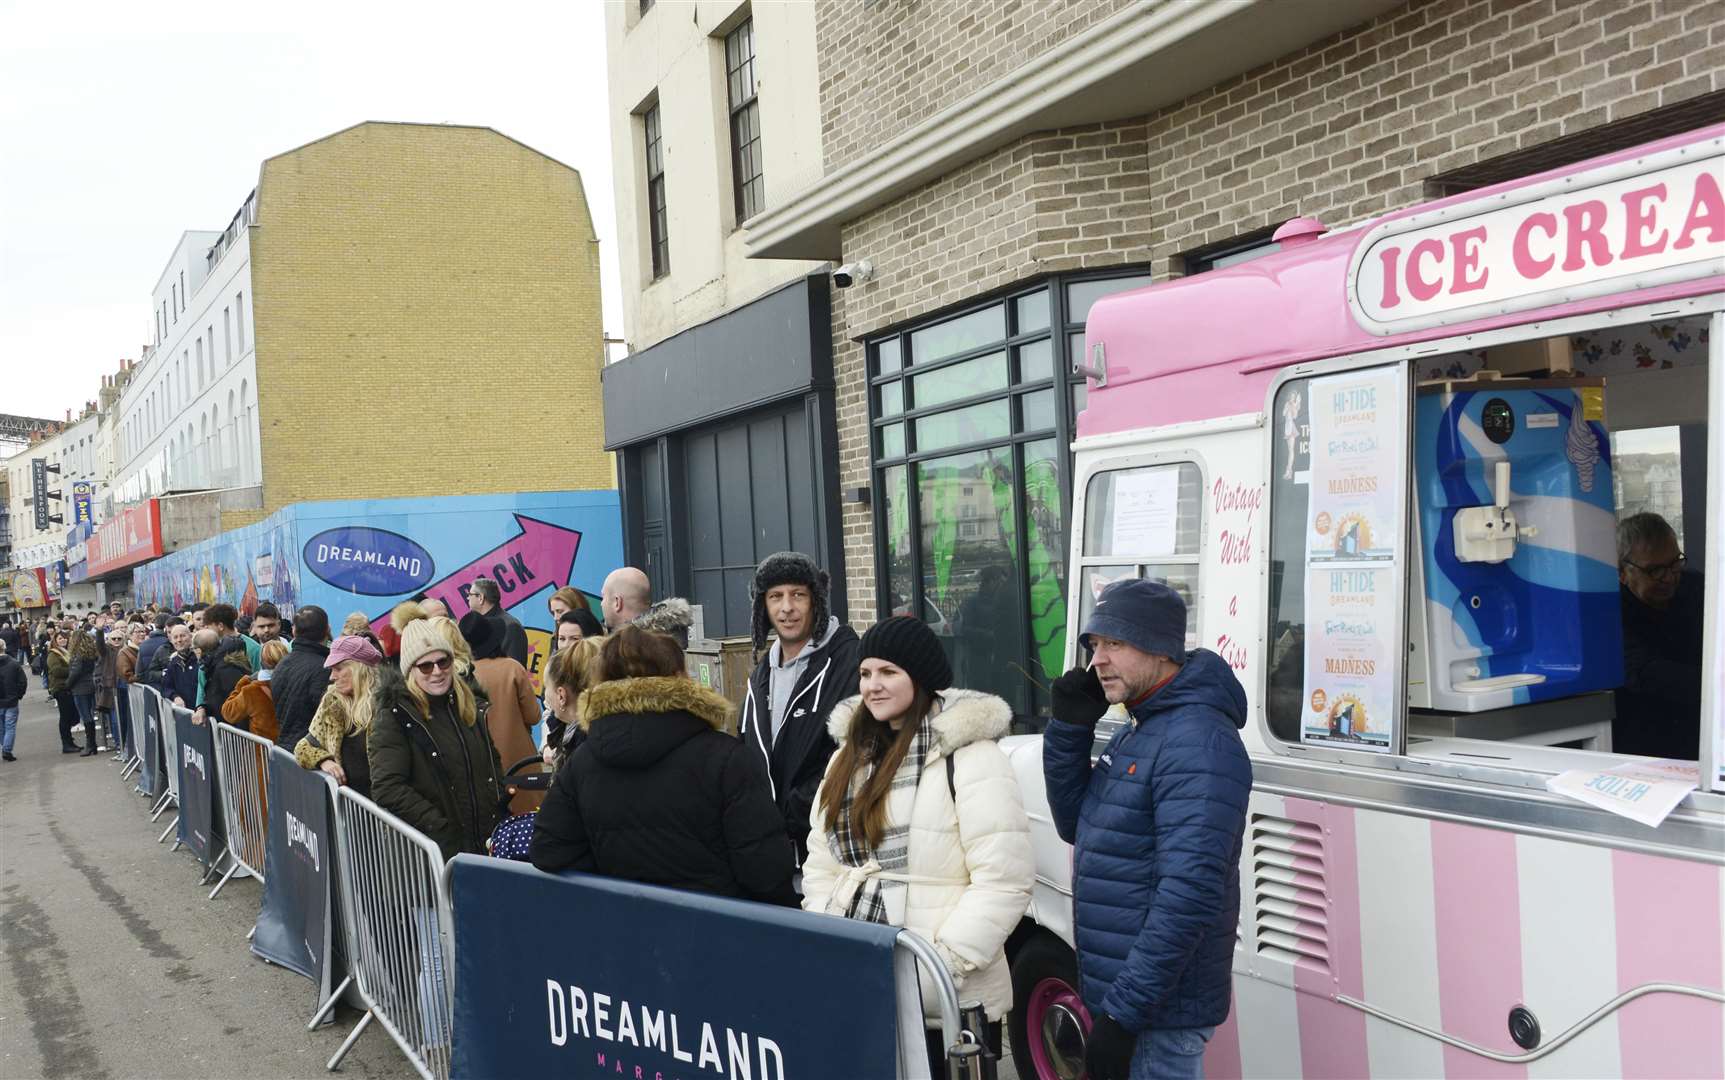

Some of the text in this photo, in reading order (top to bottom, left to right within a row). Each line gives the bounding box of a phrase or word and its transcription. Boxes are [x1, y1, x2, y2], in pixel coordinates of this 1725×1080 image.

[1380, 225, 1489, 309] ICE
[1213, 477, 1261, 522] Vintage
[1328, 476, 1376, 495] MADNESS
[317, 544, 421, 577] DREAMLAND
[1220, 528, 1251, 565] With
[1229, 595, 1237, 617] a
[1325, 658, 1376, 676] MADNESS
[547, 979, 784, 1080] DREAMLAND
[597, 1052, 682, 1080] MARG
